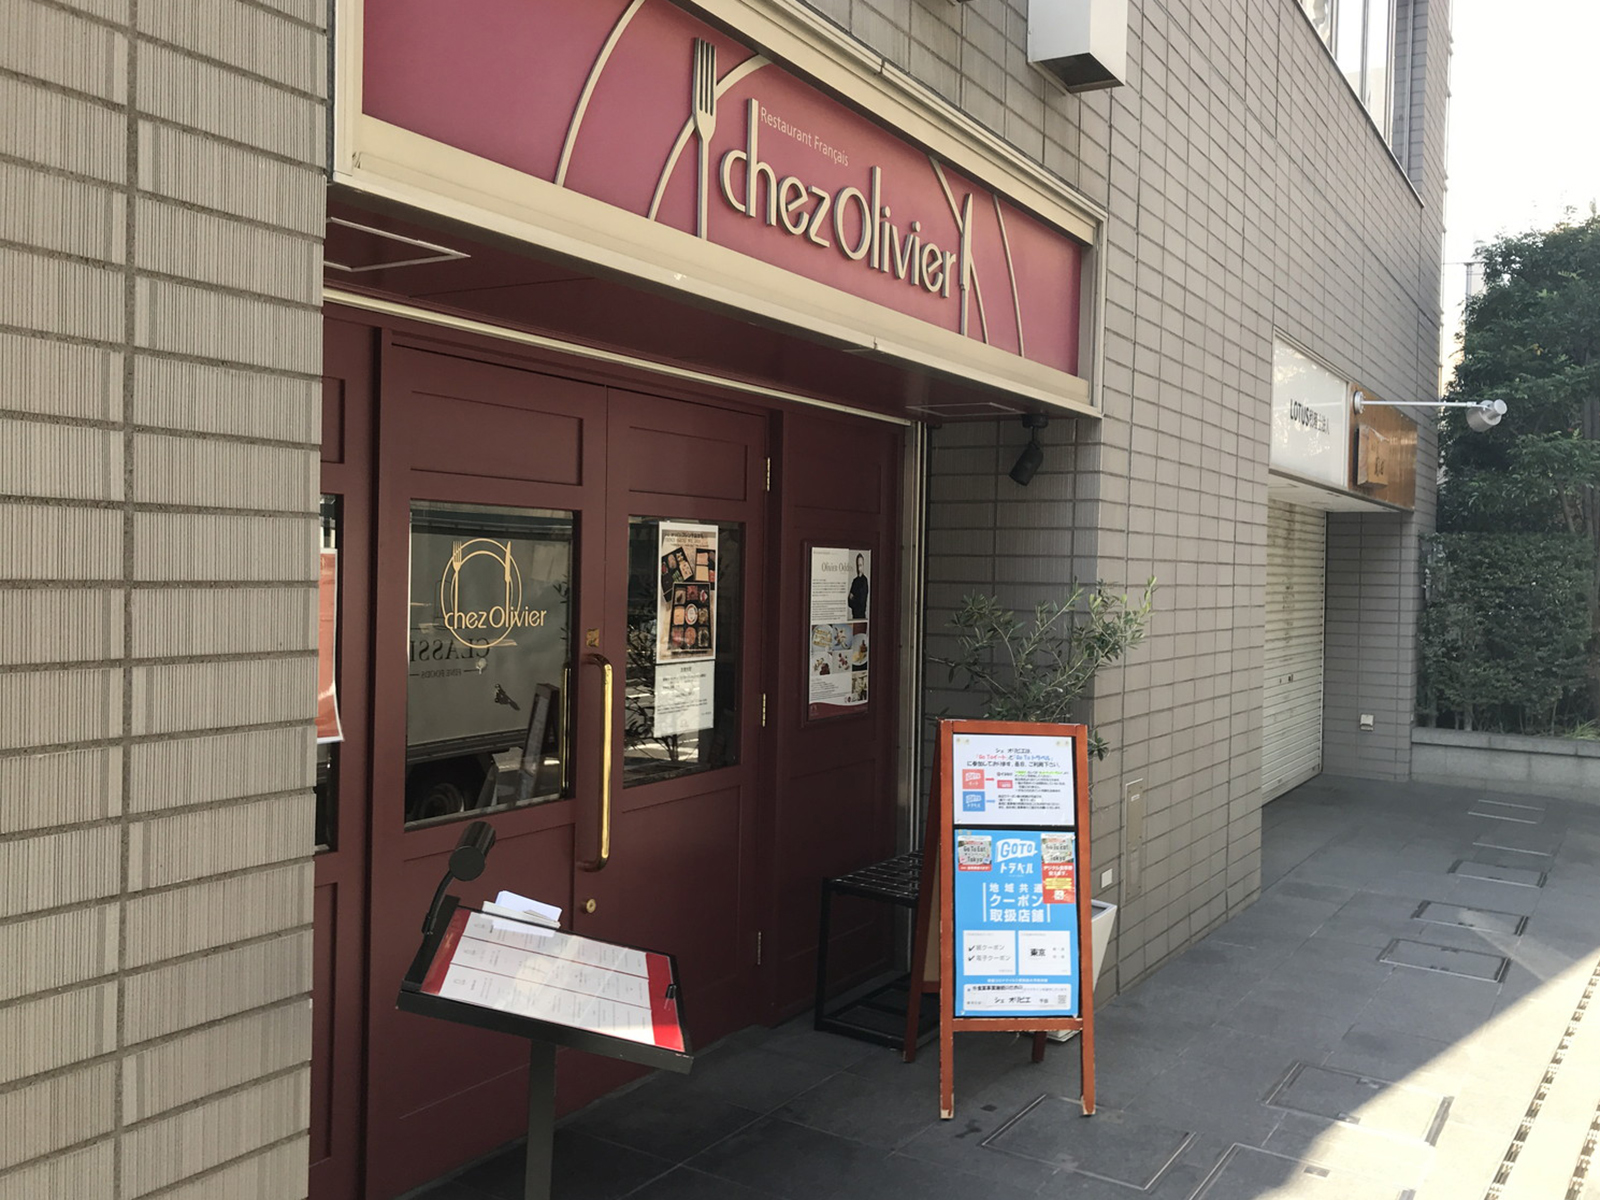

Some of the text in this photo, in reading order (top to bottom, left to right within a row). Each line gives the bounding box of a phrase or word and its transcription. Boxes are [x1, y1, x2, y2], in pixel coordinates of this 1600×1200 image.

[760, 106, 850, 167] Restaurant Français
[1000, 863, 1034, 874] トラベル
[990, 894, 1043, 907] クーポン
[990, 909, 1045, 923] 取扱店舗
